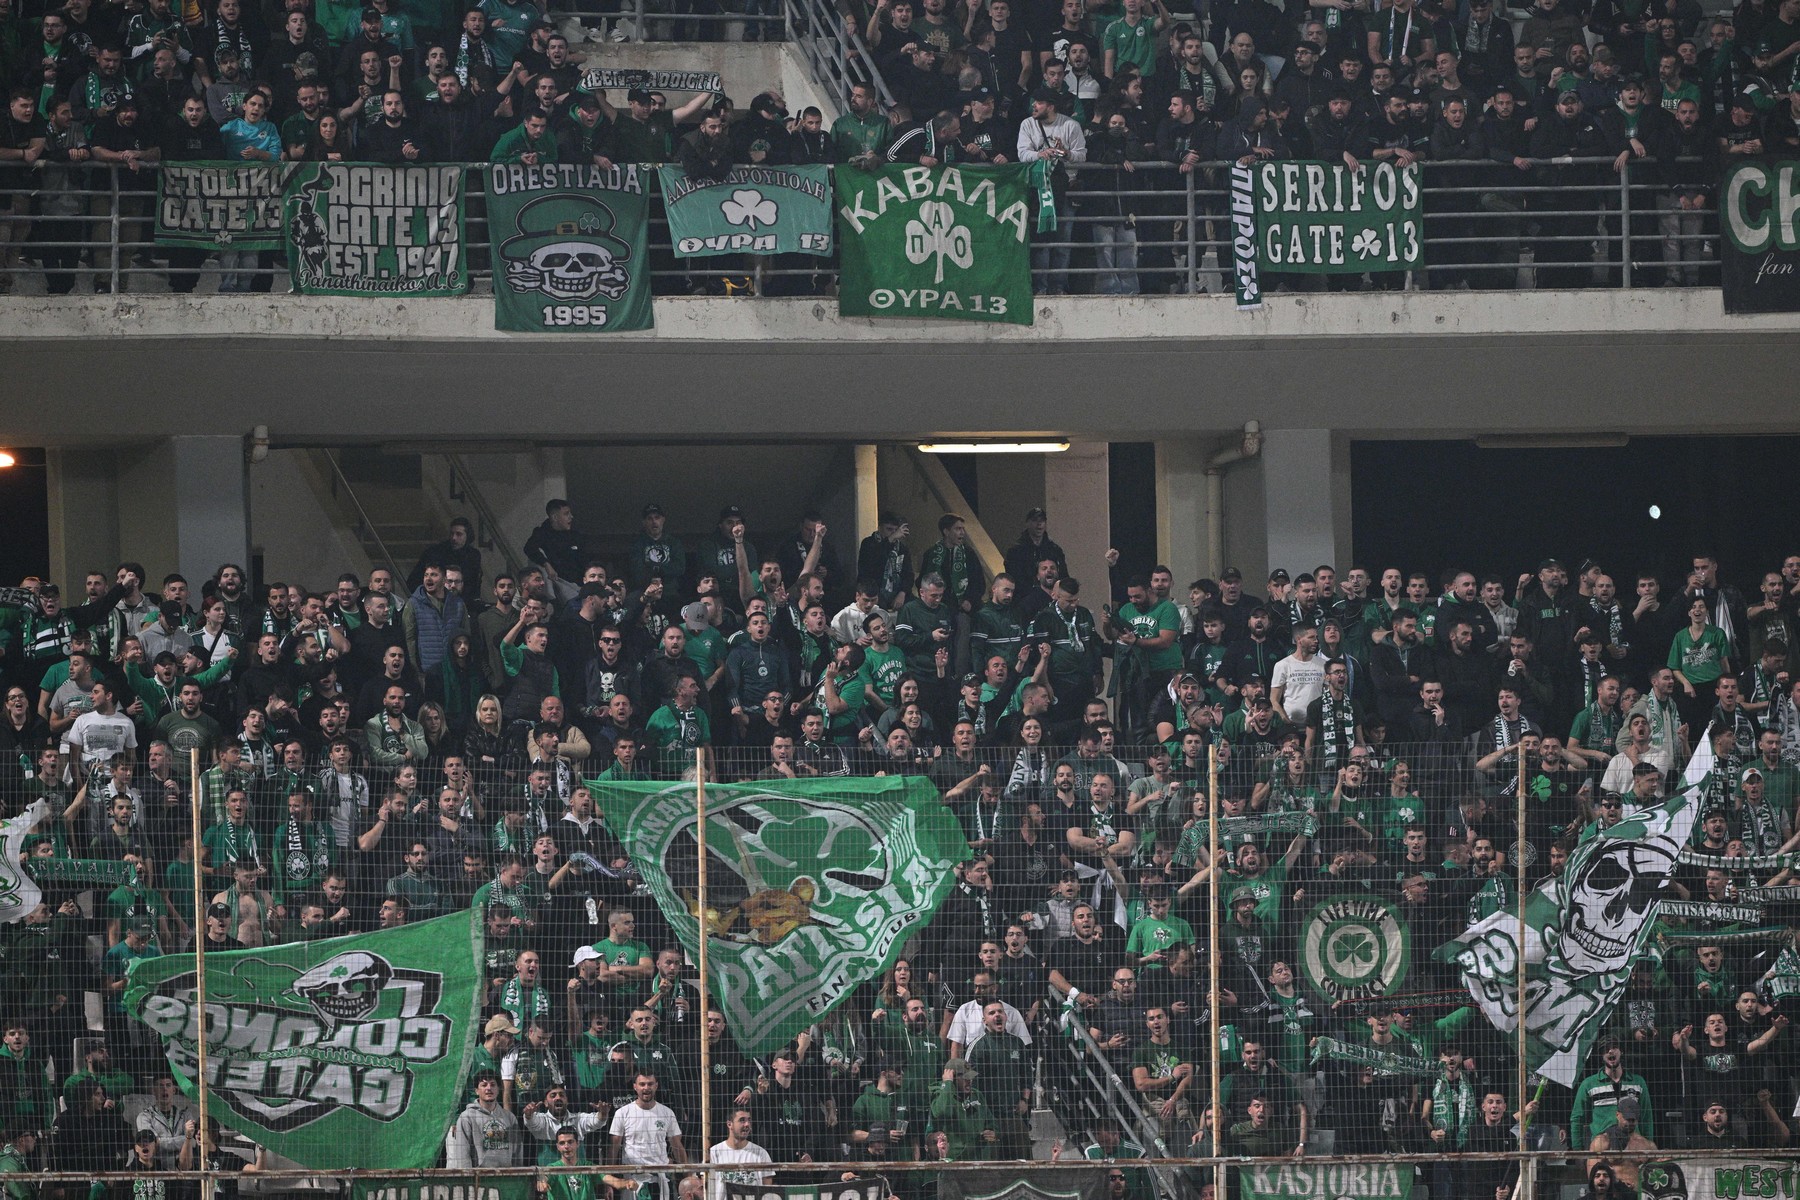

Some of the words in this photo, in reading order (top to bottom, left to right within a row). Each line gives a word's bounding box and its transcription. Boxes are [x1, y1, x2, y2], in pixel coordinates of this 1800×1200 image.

[328, 166, 460, 205] AGRINIO
[492, 163, 642, 195] ORESTIADA
[1261, 161, 1419, 213] SERIFOS
[161, 199, 249, 229] GATE
[254, 200, 284, 228] 13
[329, 206, 412, 245] GATE
[425, 204, 458, 243] 13
[1266, 222, 1345, 265] GATE
[1386, 220, 1419, 262] 13
[329, 248, 389, 278] EST.
[397, 245, 459, 279] 1997
[1755, 252, 1794, 284] fan
[300, 270, 423, 292] Panathinaikos
[542, 305, 608, 326] 1995
[969, 294, 1009, 316] 13
[38, 860, 130, 875] KAVALA
[807, 974, 846, 1013] FAN
[878, 912, 918, 958] CLUB
[1253, 1164, 1402, 1196] KASTORIA
[1715, 1165, 1794, 1199] WEST
